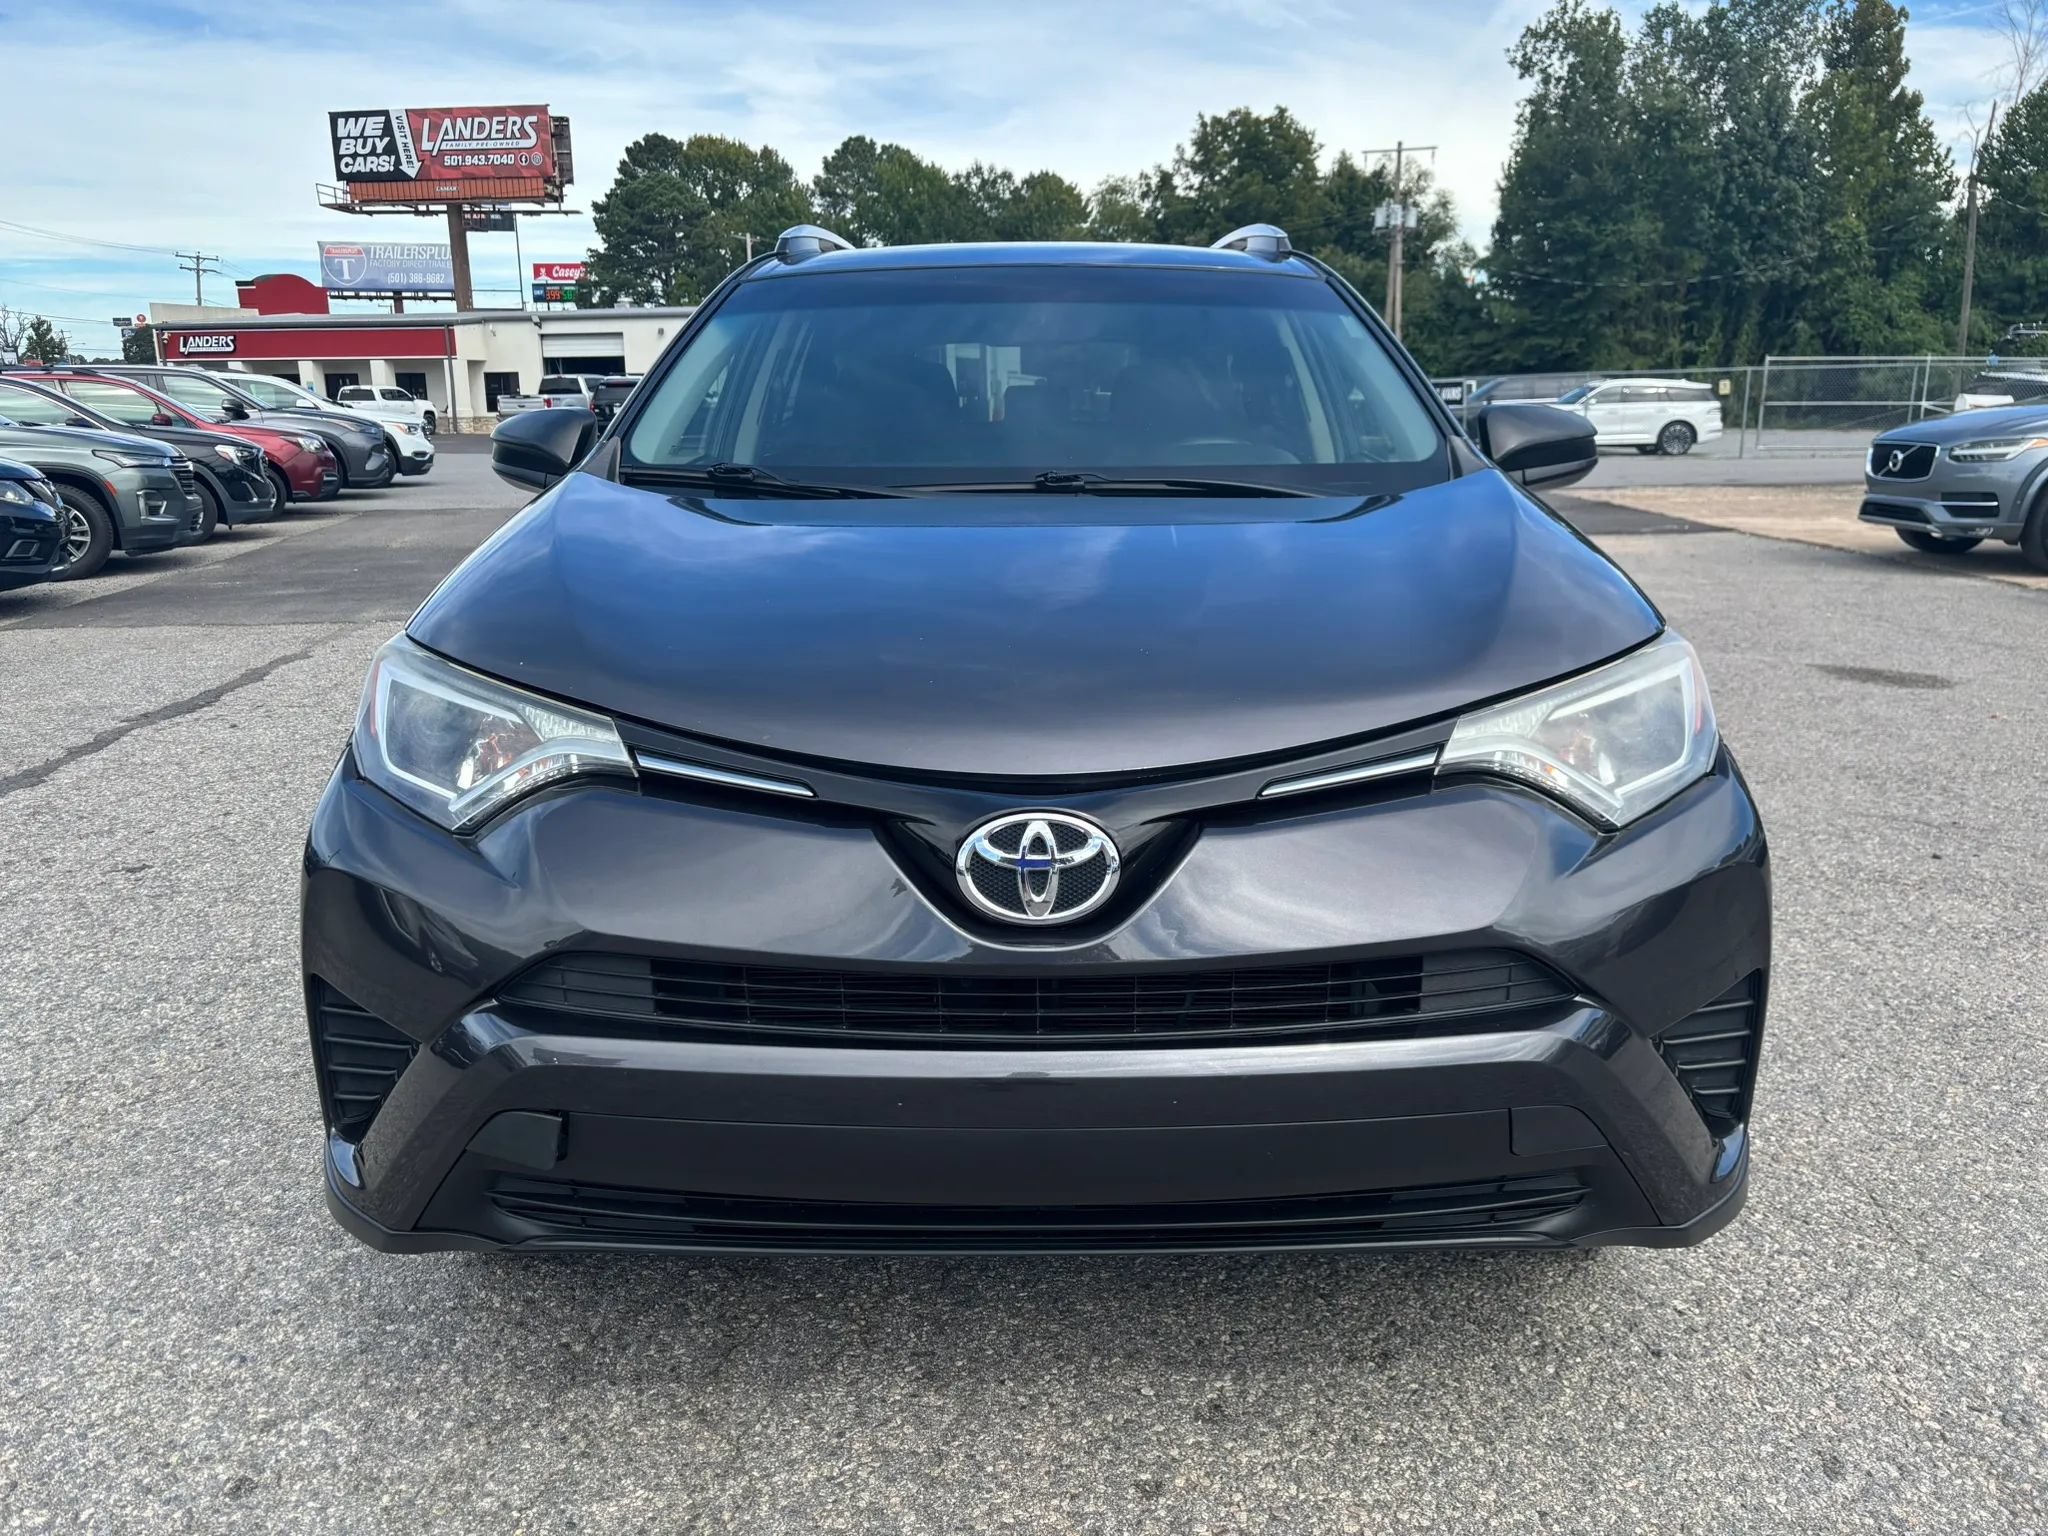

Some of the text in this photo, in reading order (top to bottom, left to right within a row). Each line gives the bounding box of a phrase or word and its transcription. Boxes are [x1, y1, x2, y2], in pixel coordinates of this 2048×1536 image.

[336, 116, 385, 138] WE
[421, 115, 538, 156] LANDERS
[339, 137, 391, 155] BUY
[395, 115, 415, 169] VISIT HERE!
[476, 140, 520, 148] PRE-OWNED
[340, 155, 395, 174] CARS!
[444, 153, 515, 167] 501.943.7040
[368, 244, 452, 260] TRAILERSPLU
[335, 258, 356, 280] T
[369, 259, 401, 268] FACTORY
[402, 259, 426, 268] DIRECT
[387, 272, 407, 285] (501)
[179, 335, 235, 355] LANDERS
